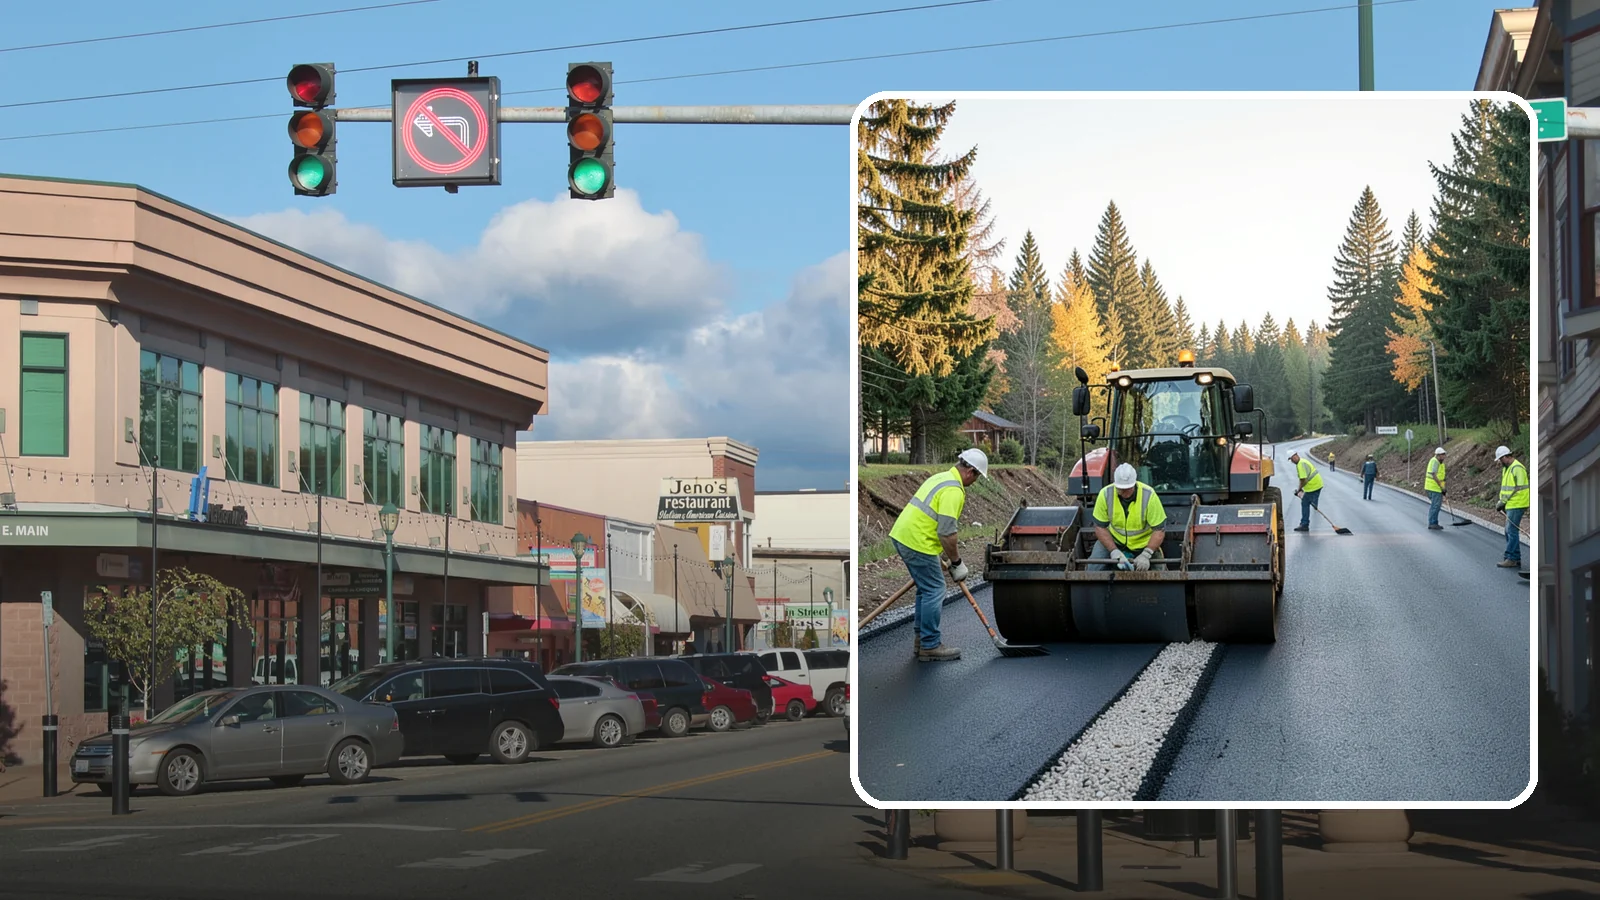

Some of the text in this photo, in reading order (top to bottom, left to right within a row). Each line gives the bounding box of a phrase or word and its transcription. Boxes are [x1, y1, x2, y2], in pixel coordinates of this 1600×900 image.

[670, 480, 727, 494] Jeno's
[665, 496, 731, 509] restaurant
[658, 509, 682, 519] Italian
[686, 509, 714, 519] American
[715, 509, 737, 519] Cuisine
[2, 525, 49, 536] E. MAIN
[797, 607, 829, 617] Street
[790, 619, 824, 627] lass
